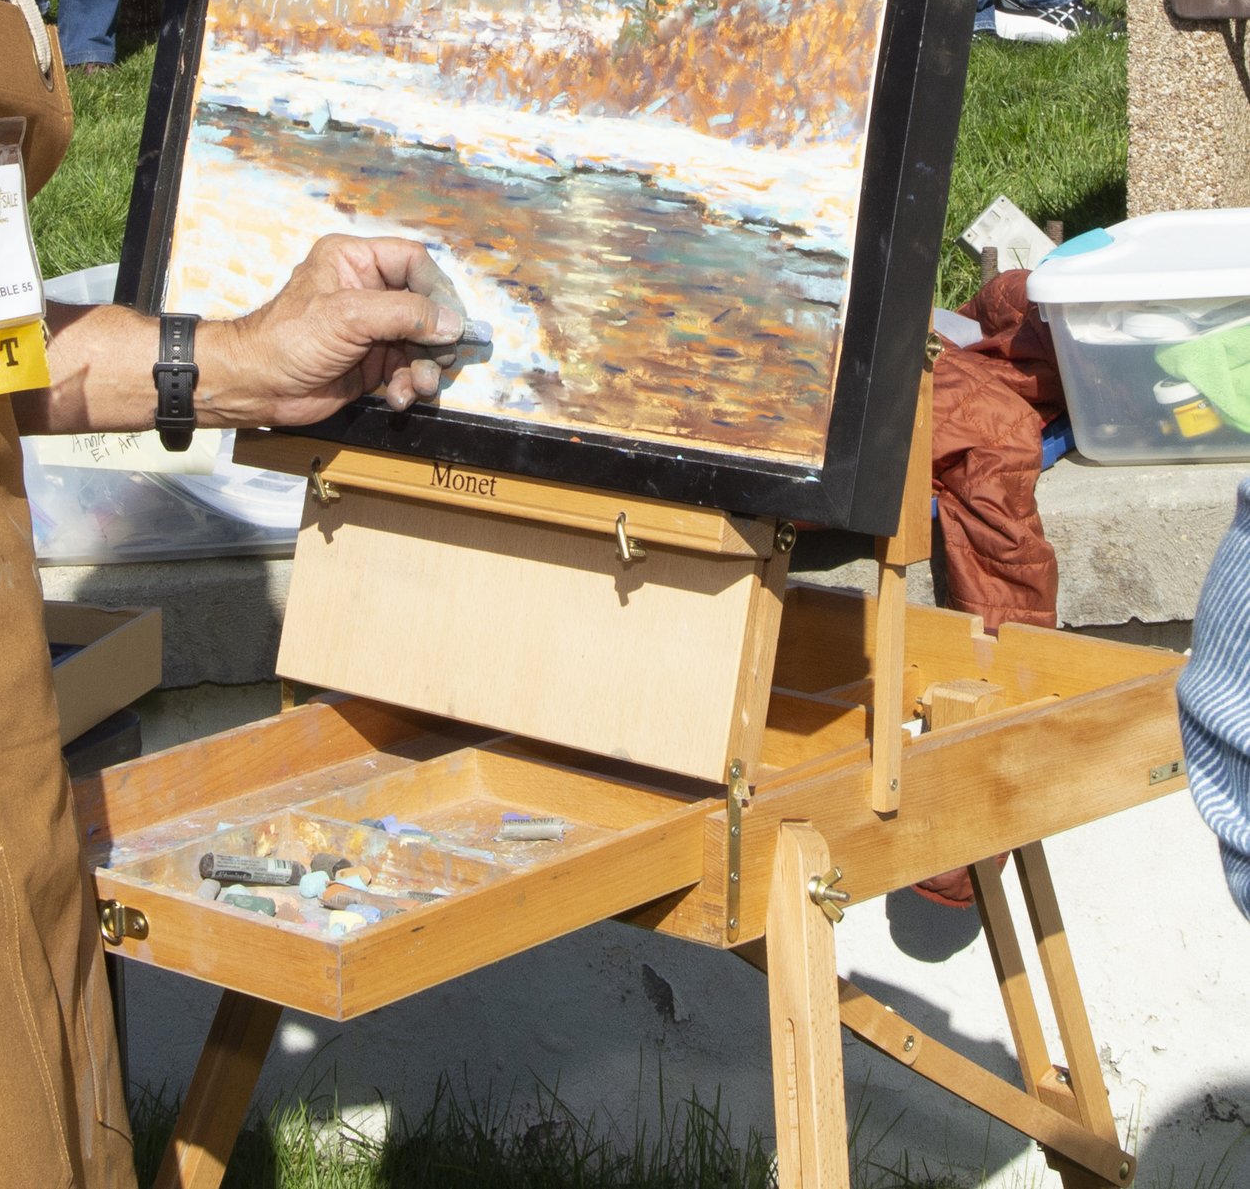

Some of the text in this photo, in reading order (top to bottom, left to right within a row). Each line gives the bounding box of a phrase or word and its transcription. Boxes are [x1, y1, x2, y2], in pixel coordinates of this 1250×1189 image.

[2, 193, 19, 209] SALE
[22, 281, 33, 293] 55
[430, 461, 497, 496] Monet
